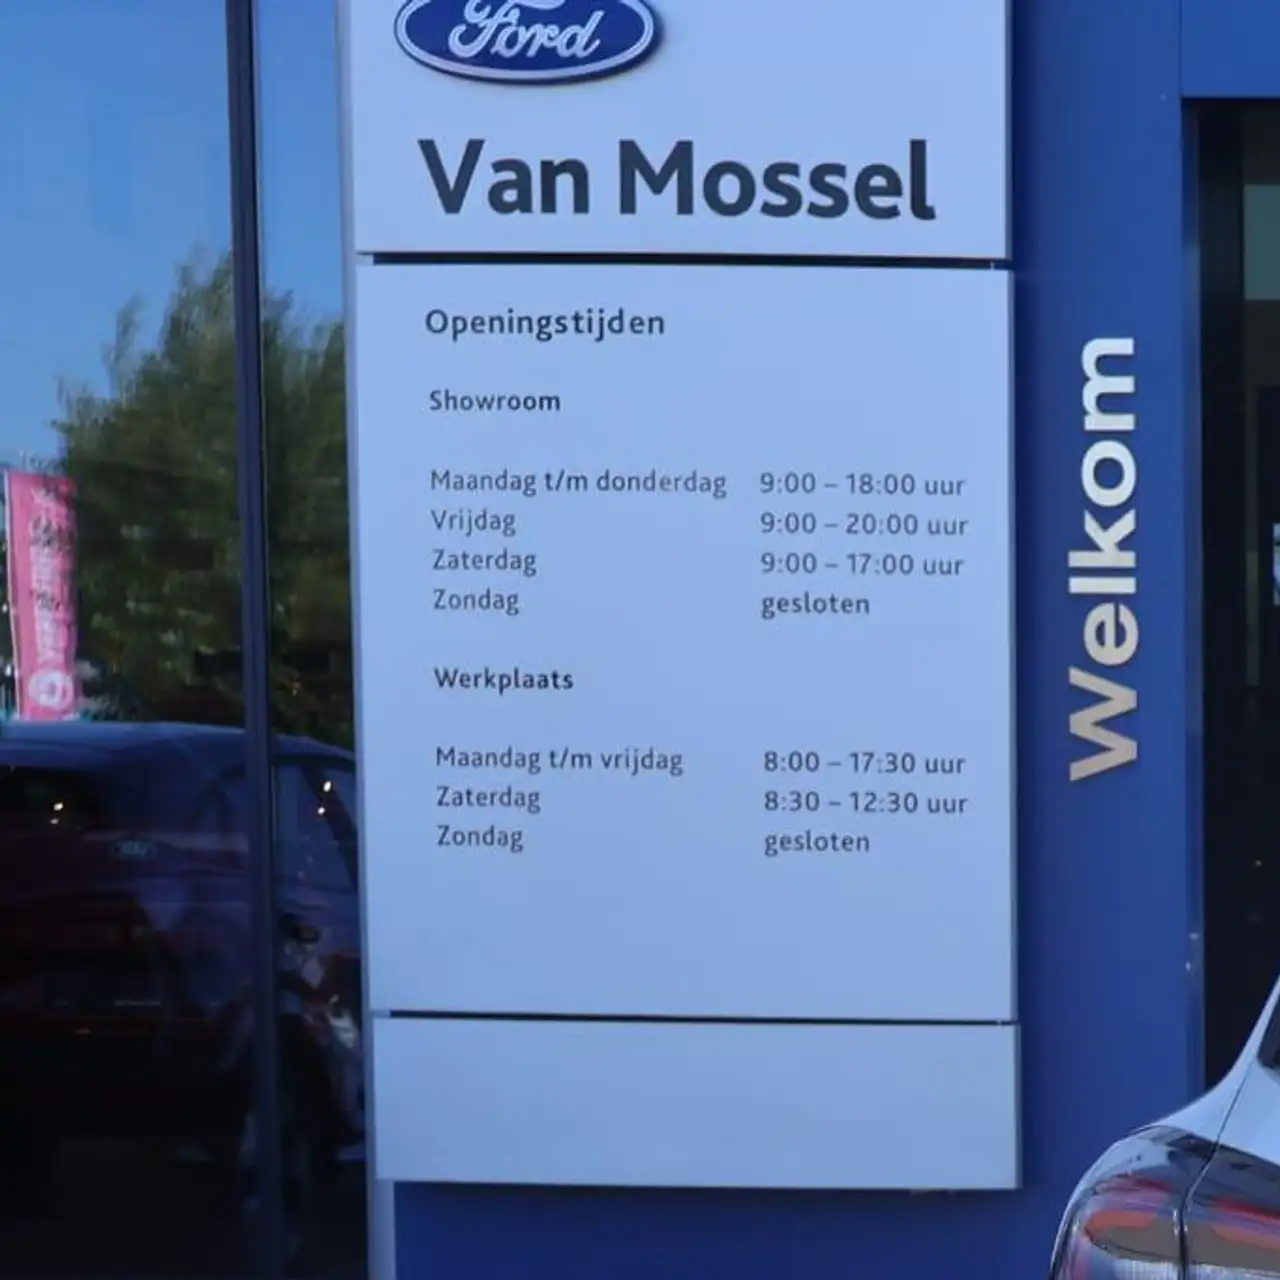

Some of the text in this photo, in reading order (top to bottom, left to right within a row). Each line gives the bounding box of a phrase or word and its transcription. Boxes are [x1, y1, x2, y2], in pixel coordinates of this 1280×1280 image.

[449, 0, 605, 58] Ford
[418, 139, 937, 220] Van Mossel
[426, 308, 665, 342] Openingstijden
[430, 389, 561, 412] Showroom
[431, 468, 727, 499] Maandag t/m donderdag
[760, 472, 816, 494] 9:00
[846, 473, 916, 495] 18:00
[924, 479, 965, 496] uur
[431, 509, 517, 537] Vrijdag
[761, 512, 817, 534] 9:00
[846, 513, 919, 535] 20:00
[927, 519, 969, 536] uur
[433, 548, 538, 578] Zaterdag
[761, 552, 818, 574] 9:00
[847, 553, 915, 575] 17:00
[922, 559, 965, 576] uur
[1068, 338, 1139, 782] Welkom
[434, 588, 520, 617] Zondag
[762, 591, 870, 620] gesloten
[434, 667, 574, 696] Werkplaats
[437, 746, 684, 776] Maandag t/m vrijdag
[765, 751, 820, 772] 8:00
[849, 752, 916, 773] 17:30
[924, 758, 966, 774] uur
[437, 786, 542, 814] Zaterdag
[765, 791, 820, 812] 8:30
[850, 792, 919, 814] 12:30
[927, 797, 969, 813] uur
[438, 825, 525, 853] Zondag
[765, 830, 870, 858] gesloten
